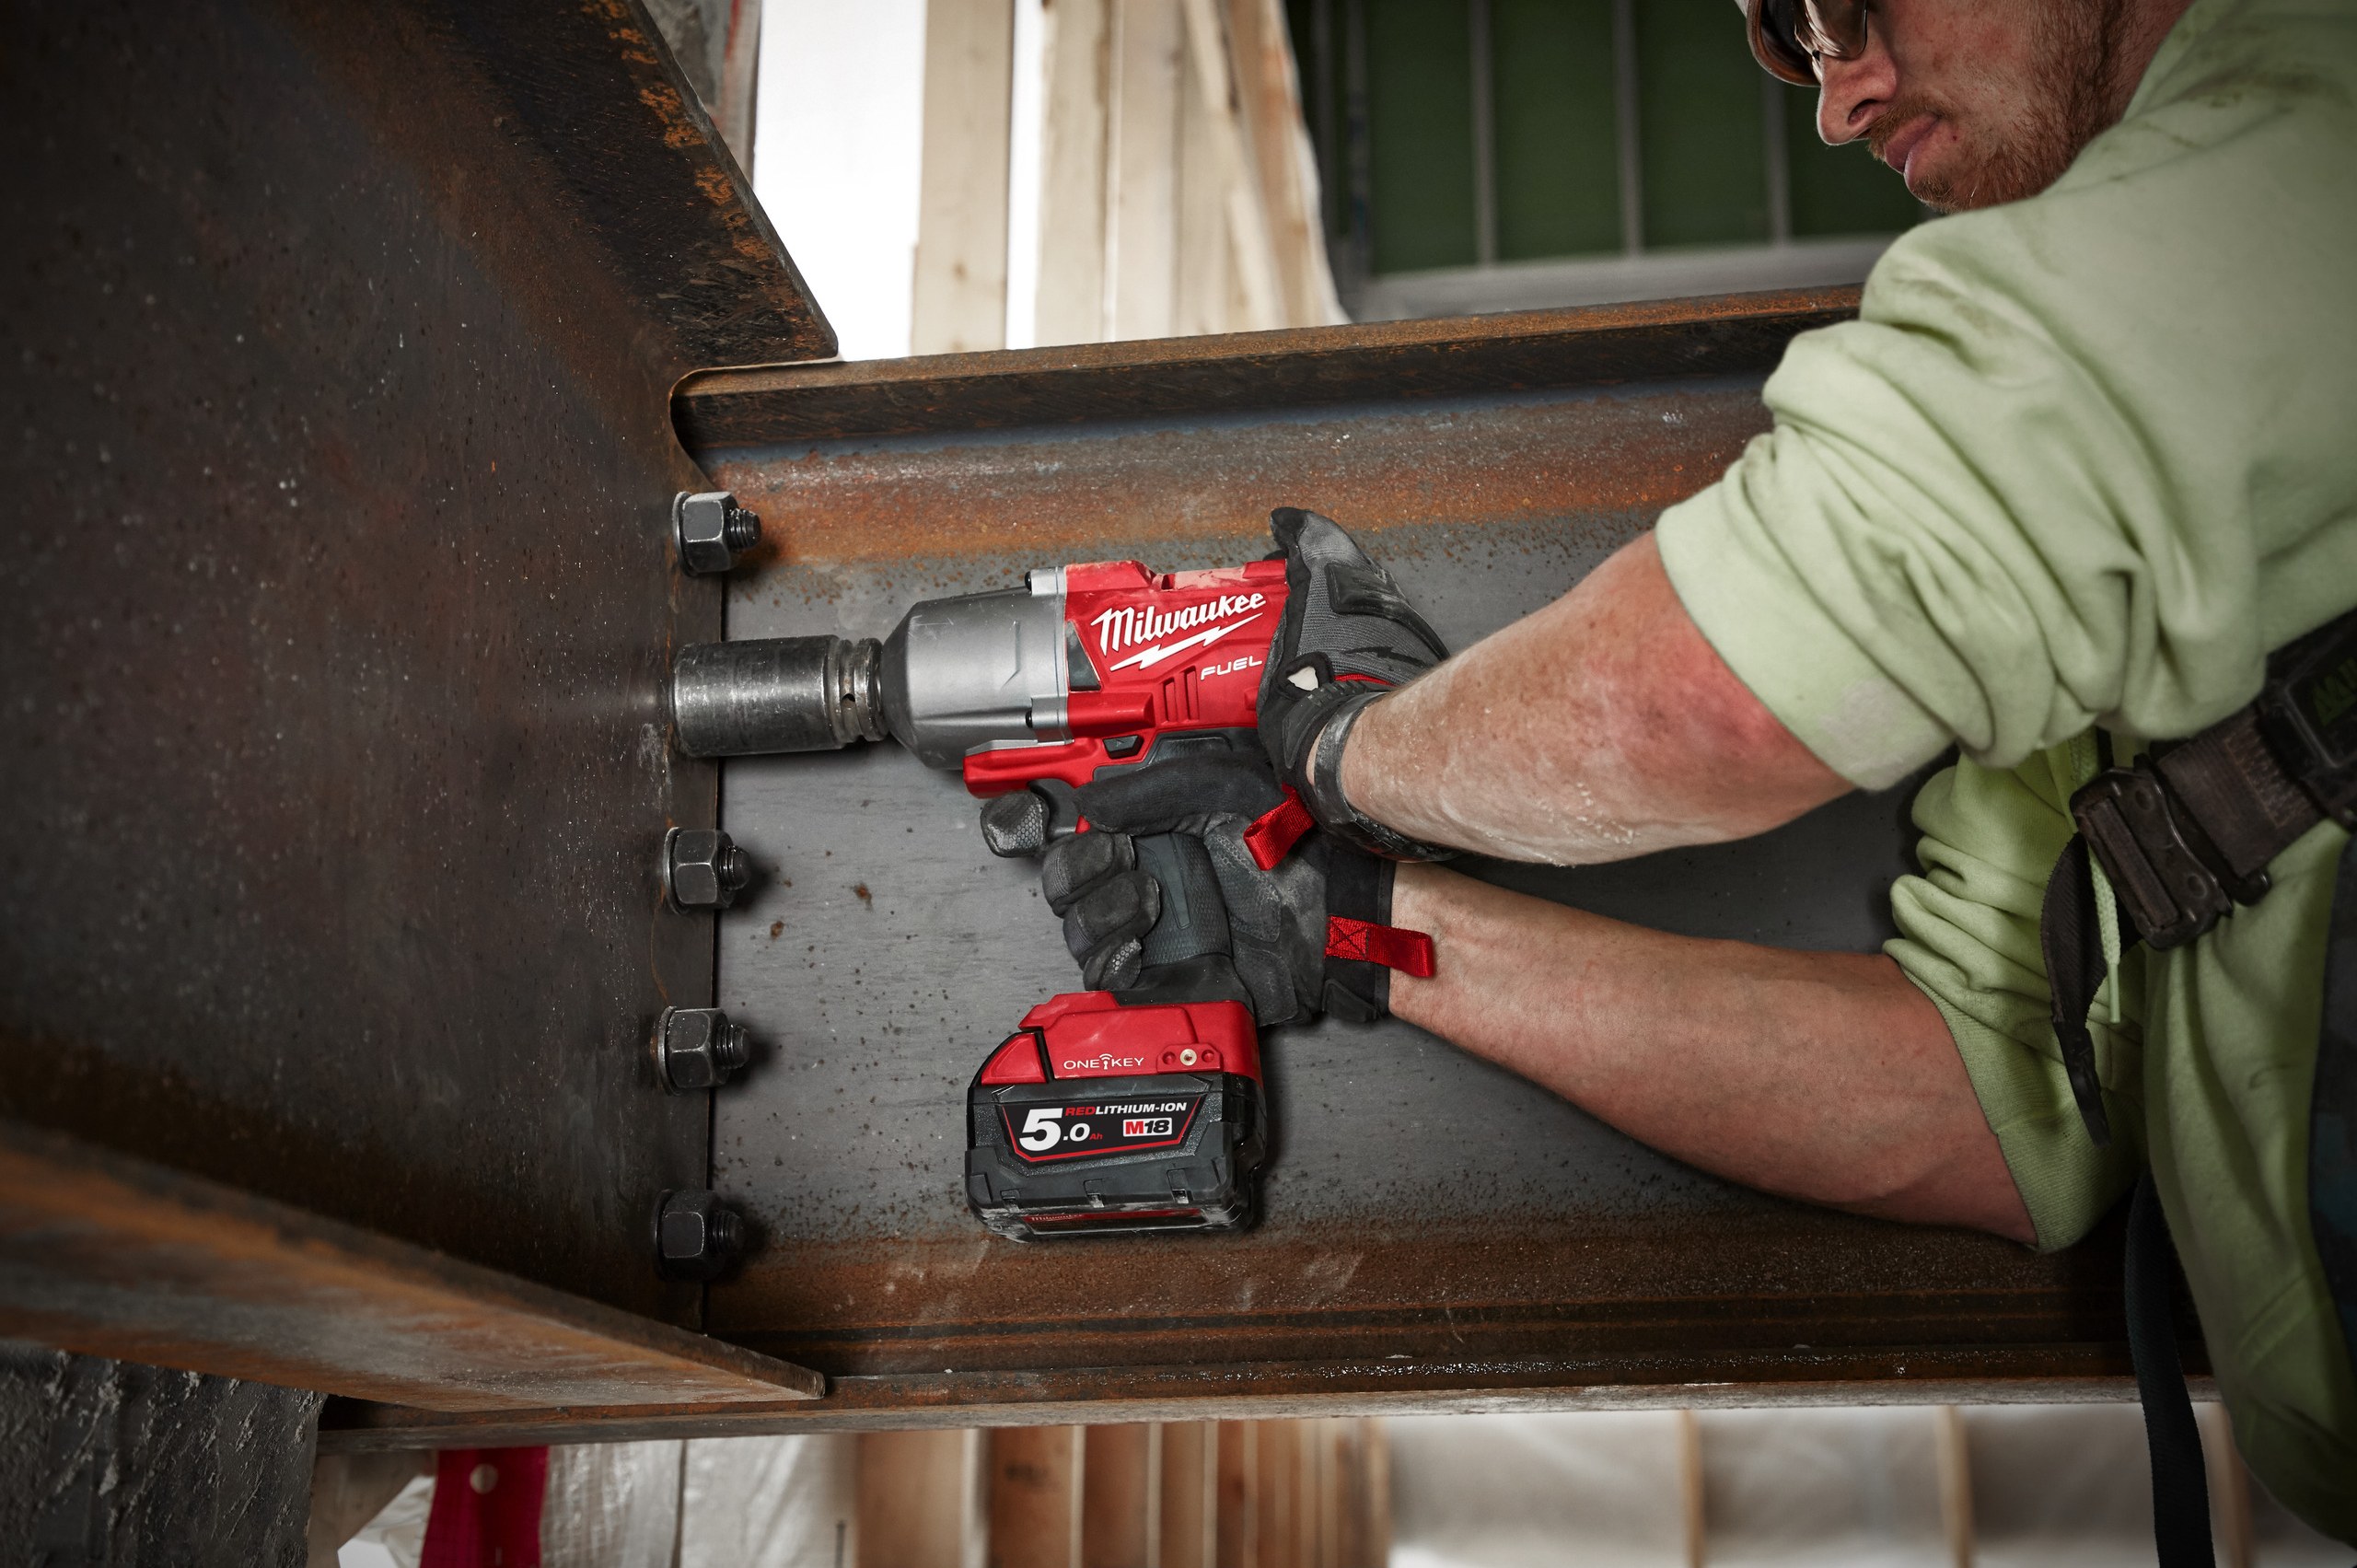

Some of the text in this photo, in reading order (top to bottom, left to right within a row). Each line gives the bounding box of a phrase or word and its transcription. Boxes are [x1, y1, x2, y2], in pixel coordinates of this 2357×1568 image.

[1091, 592, 1266, 656] Milwaukee
[1201, 655, 1262, 680] FUEL
[1124, 1120, 1170, 1135] M18
